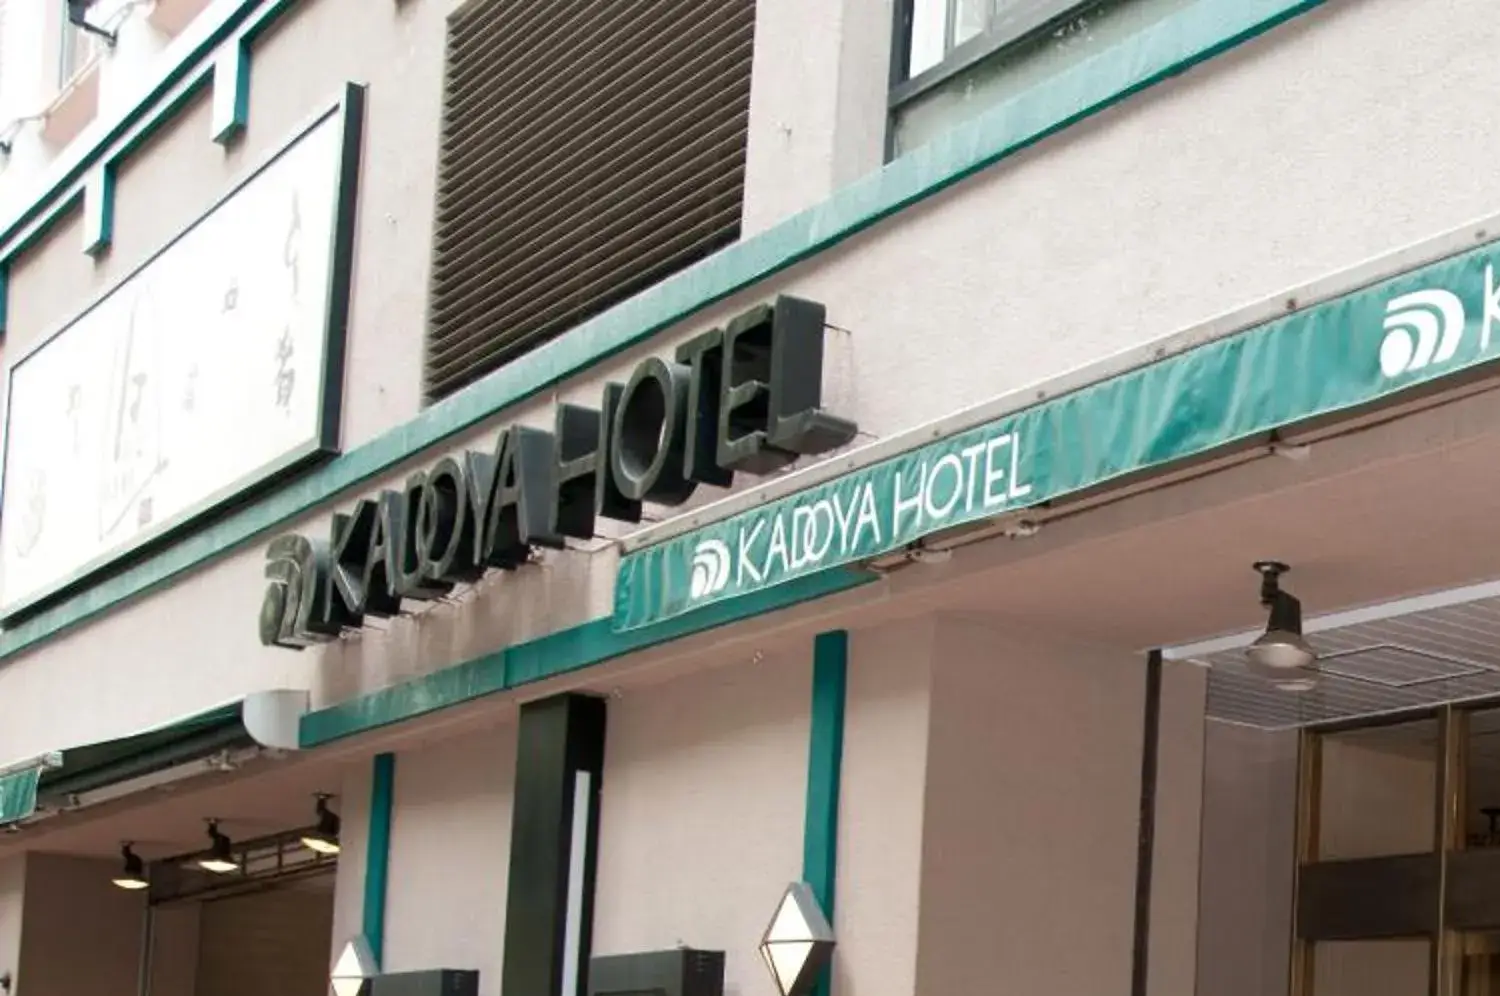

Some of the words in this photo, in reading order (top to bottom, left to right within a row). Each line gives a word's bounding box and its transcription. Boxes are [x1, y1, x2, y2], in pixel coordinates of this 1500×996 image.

[324, 424, 563, 625] KADOYA
[552, 294, 858, 538] HOTEL
[735, 479, 882, 587] KADOYA
[892, 431, 1033, 535] HOTEL
